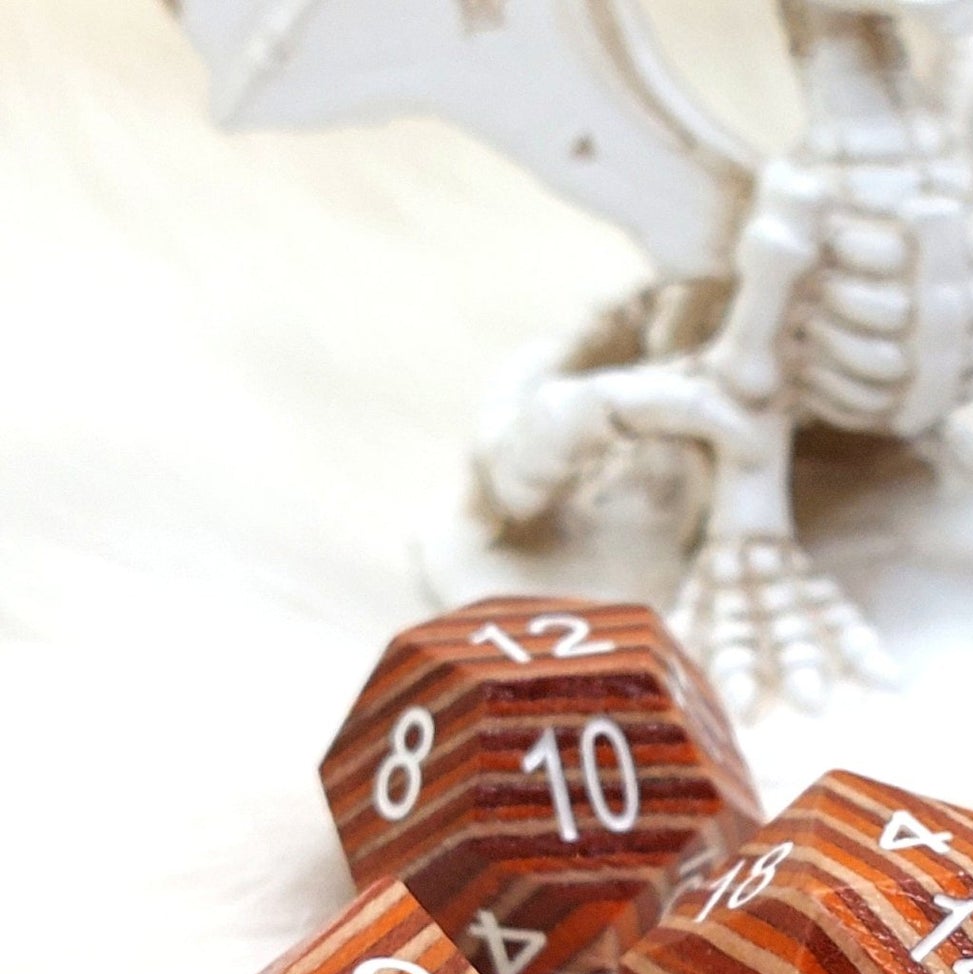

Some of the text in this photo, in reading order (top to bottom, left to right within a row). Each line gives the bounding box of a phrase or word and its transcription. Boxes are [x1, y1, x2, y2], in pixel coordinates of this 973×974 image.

[471, 614, 615, 664] 12
[374, 707, 435, 820] 8
[522, 717, 640, 842] 10
[878, 810, 952, 854] 4
[694, 842, 793, 923] 18
